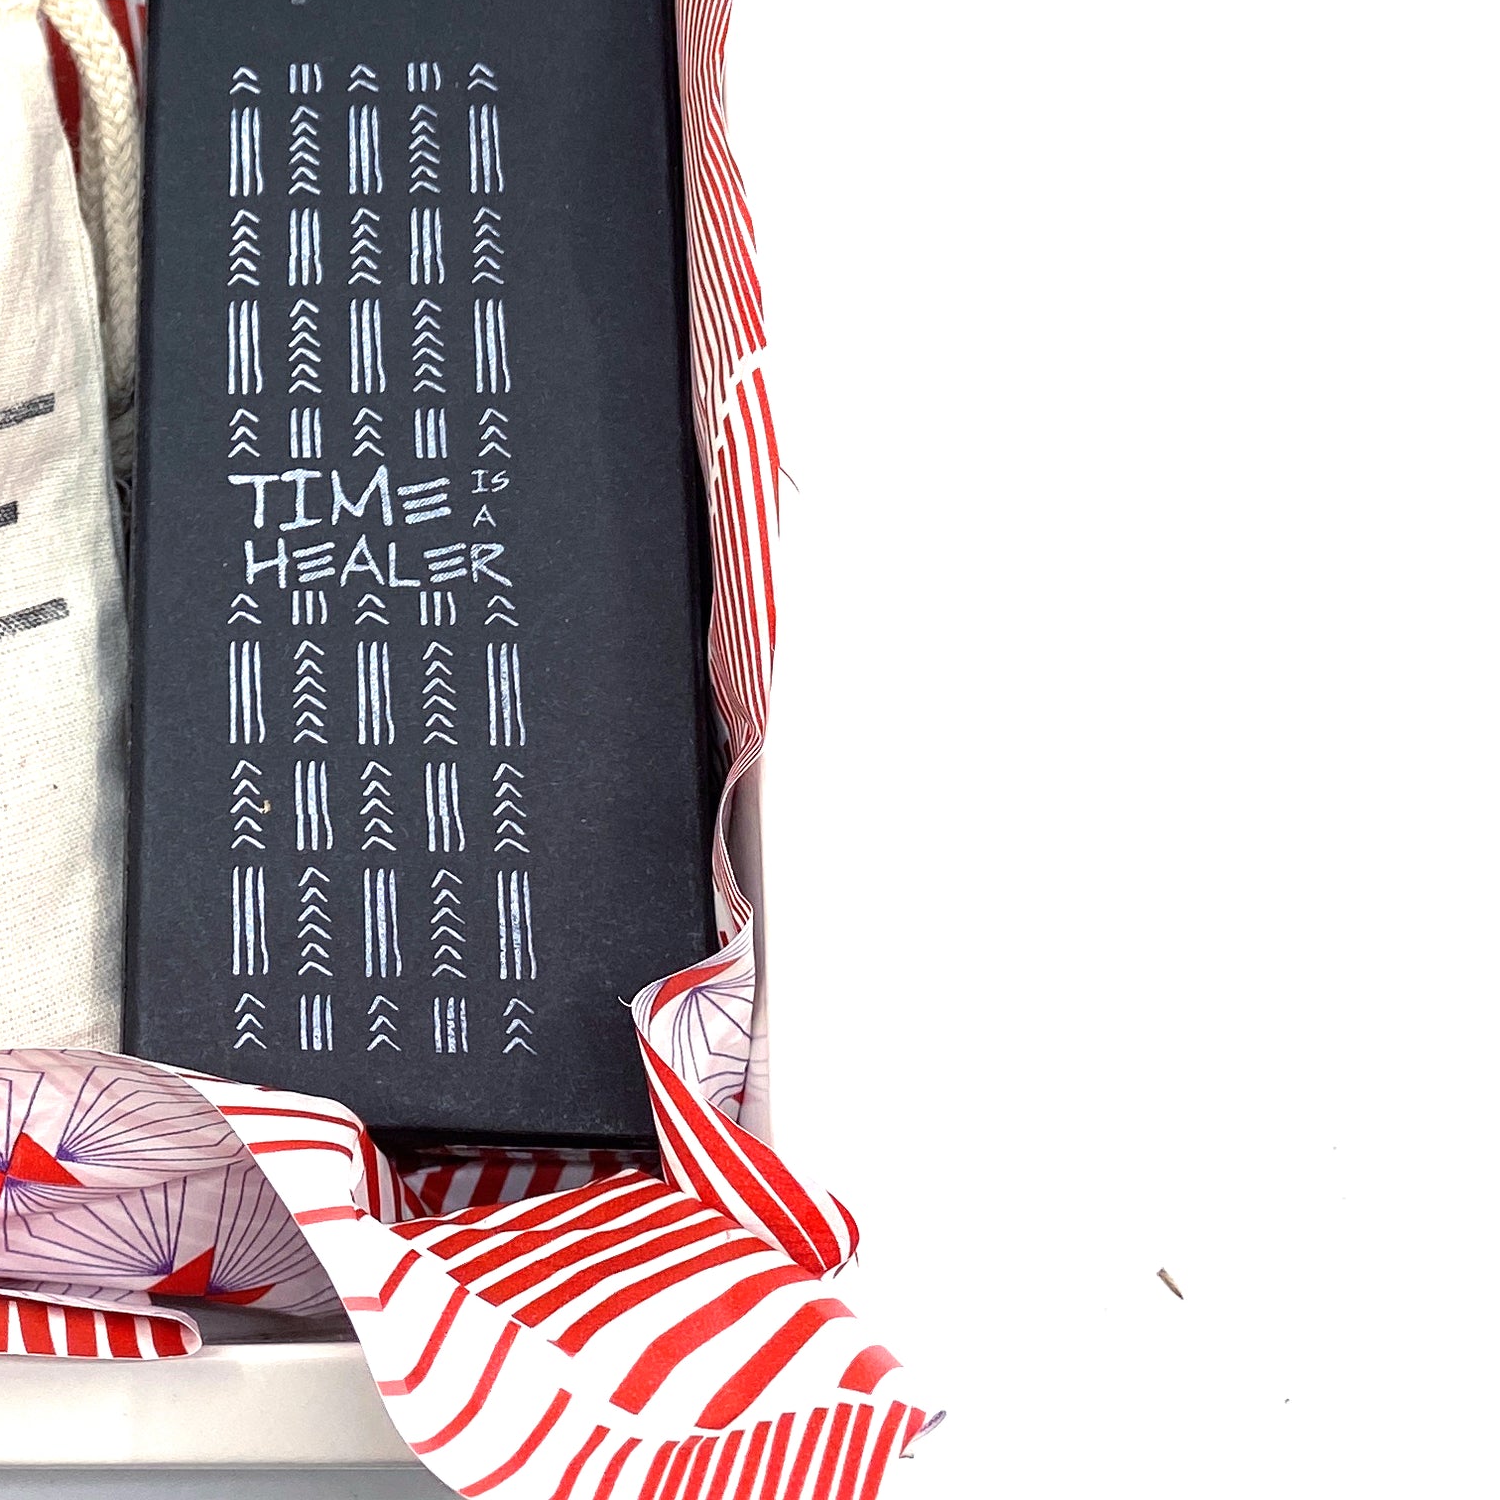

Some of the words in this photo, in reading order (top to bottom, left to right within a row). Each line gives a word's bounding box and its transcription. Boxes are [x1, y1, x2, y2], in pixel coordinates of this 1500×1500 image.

[227, 464, 452, 531] TIME
[470, 468, 510, 494] IS
[471, 503, 497, 528] A
[243, 534, 513, 588] HEALER
